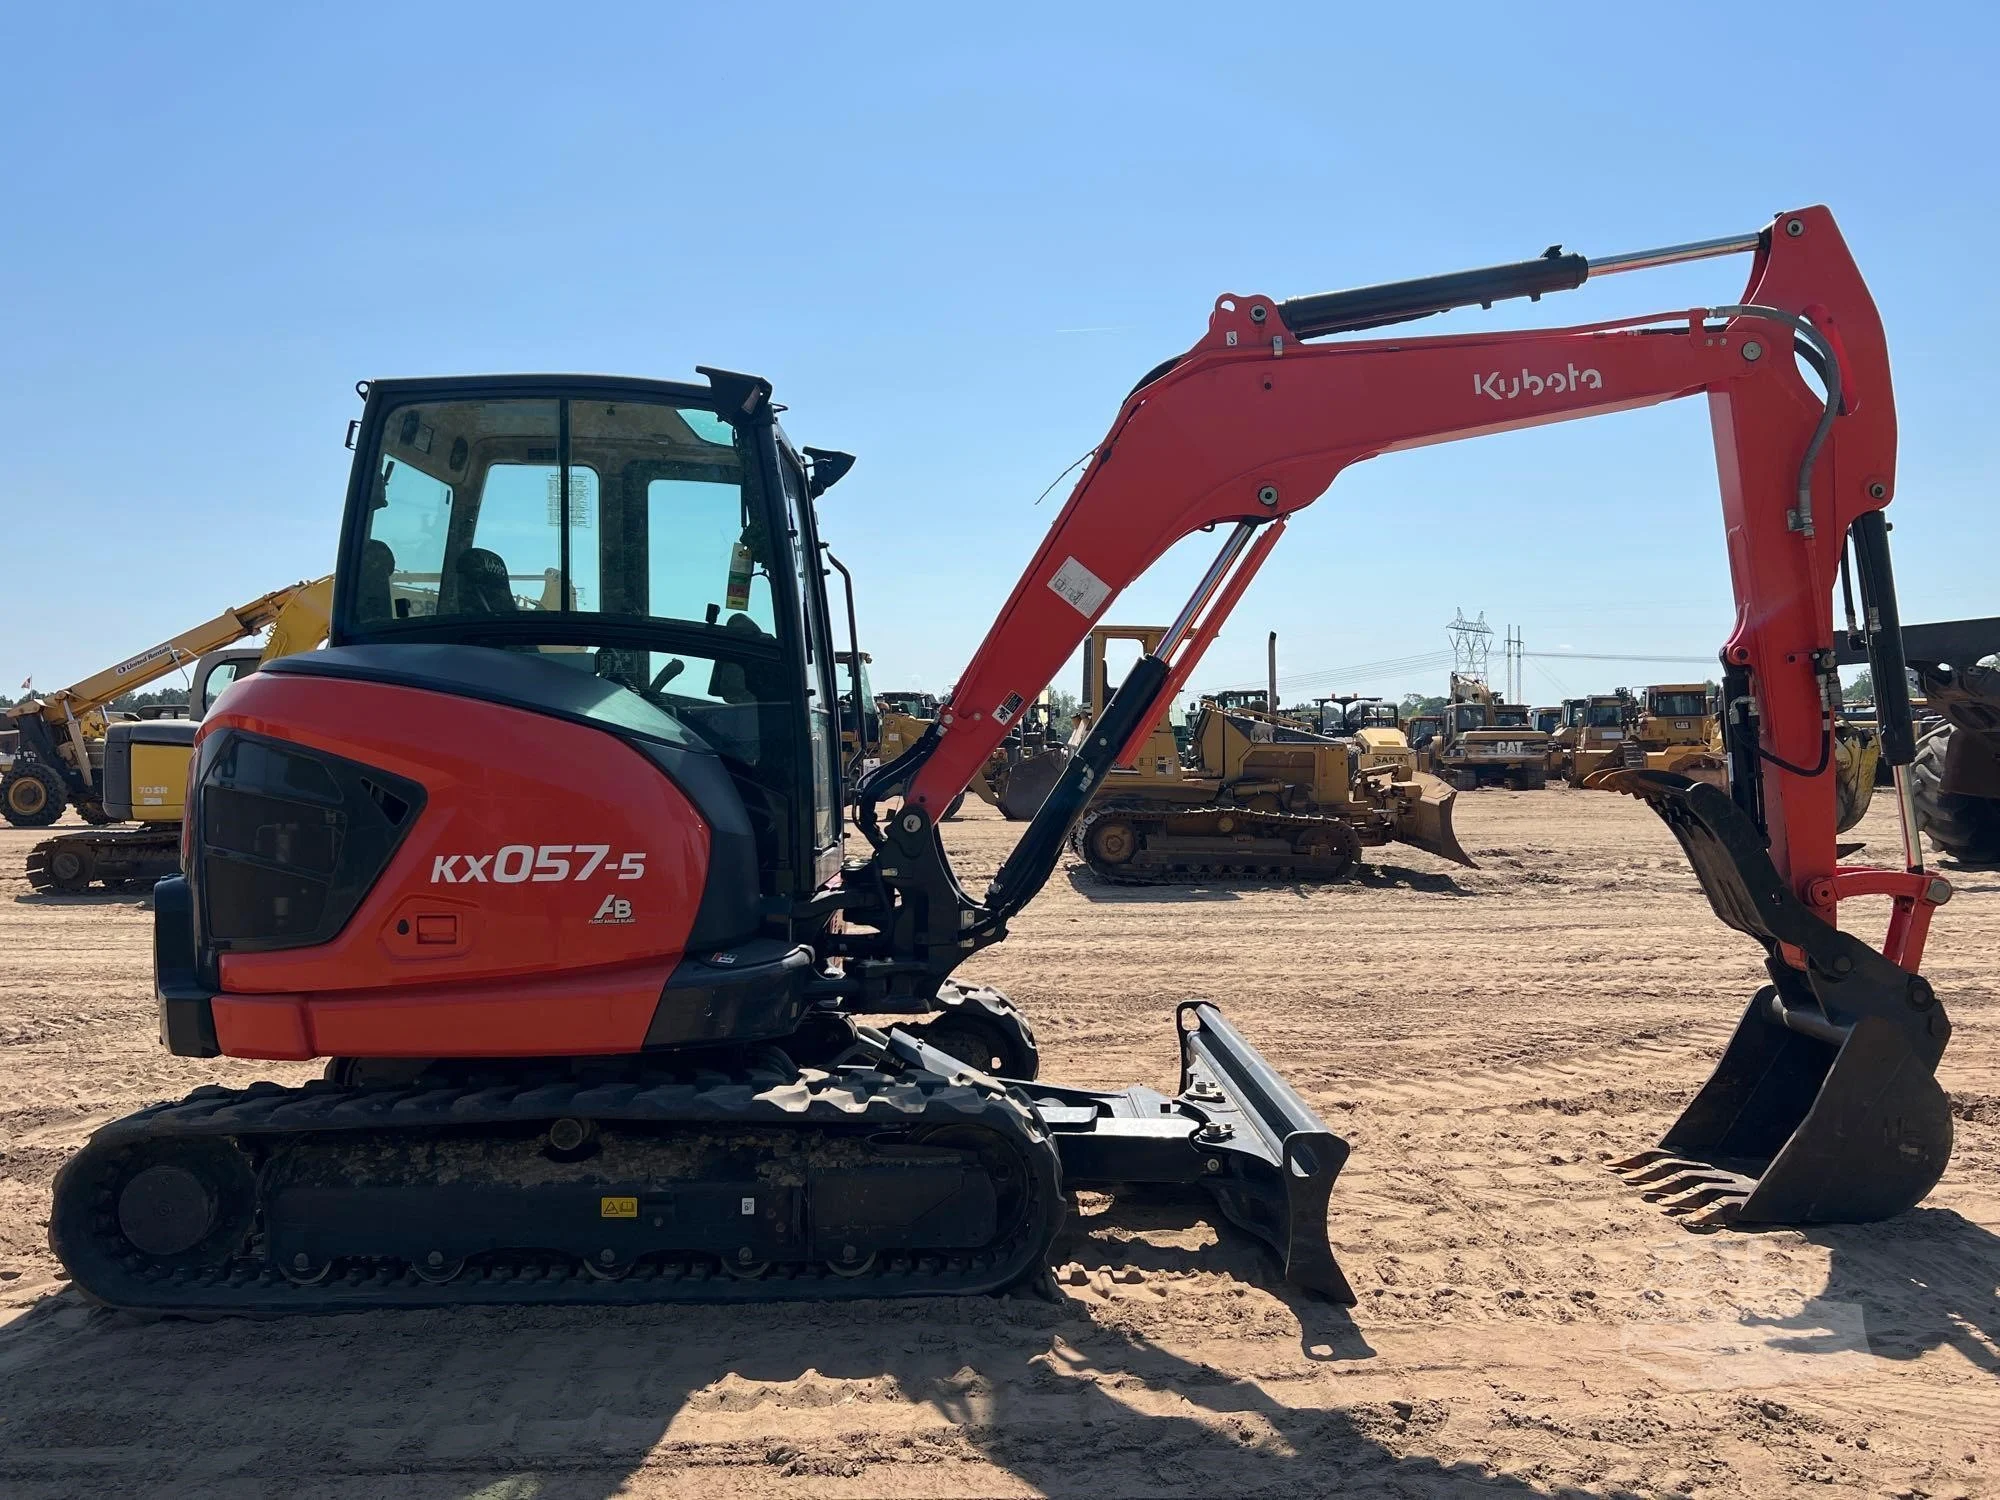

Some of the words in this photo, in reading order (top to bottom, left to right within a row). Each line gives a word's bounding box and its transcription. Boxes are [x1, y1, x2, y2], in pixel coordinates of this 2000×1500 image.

[1474, 363, 1603, 400] Kubota
[126, 655, 148, 670] United
[148, 645, 171, 660] Rentals
[1497, 741, 1524, 755] CAT
[430, 844, 648, 884] KX057-5
